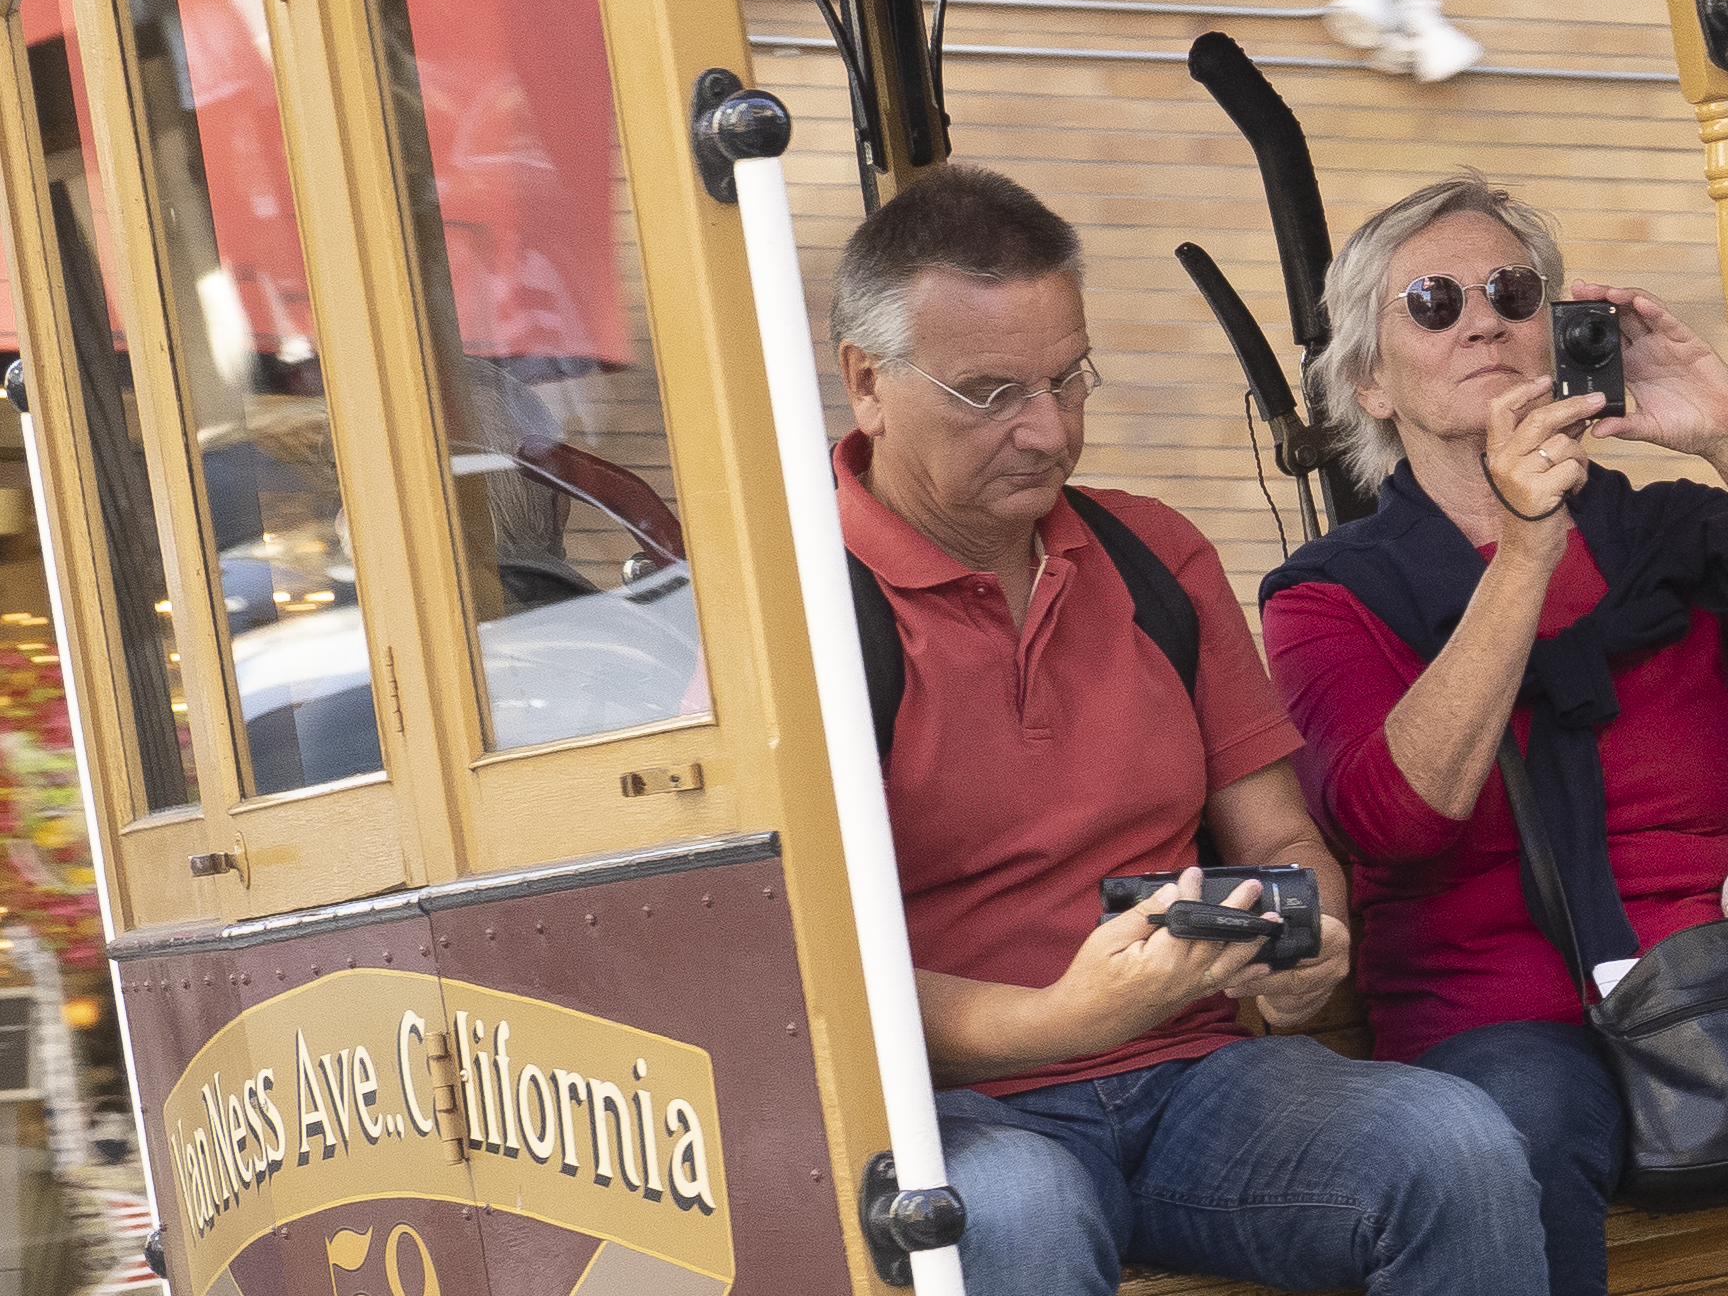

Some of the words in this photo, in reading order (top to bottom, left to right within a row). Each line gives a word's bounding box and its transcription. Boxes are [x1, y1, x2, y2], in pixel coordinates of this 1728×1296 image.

[170, 1119, 221, 1244] Van
[201, 1069, 286, 1200] Ness
[398, 1009, 718, 1217] Clifornia
